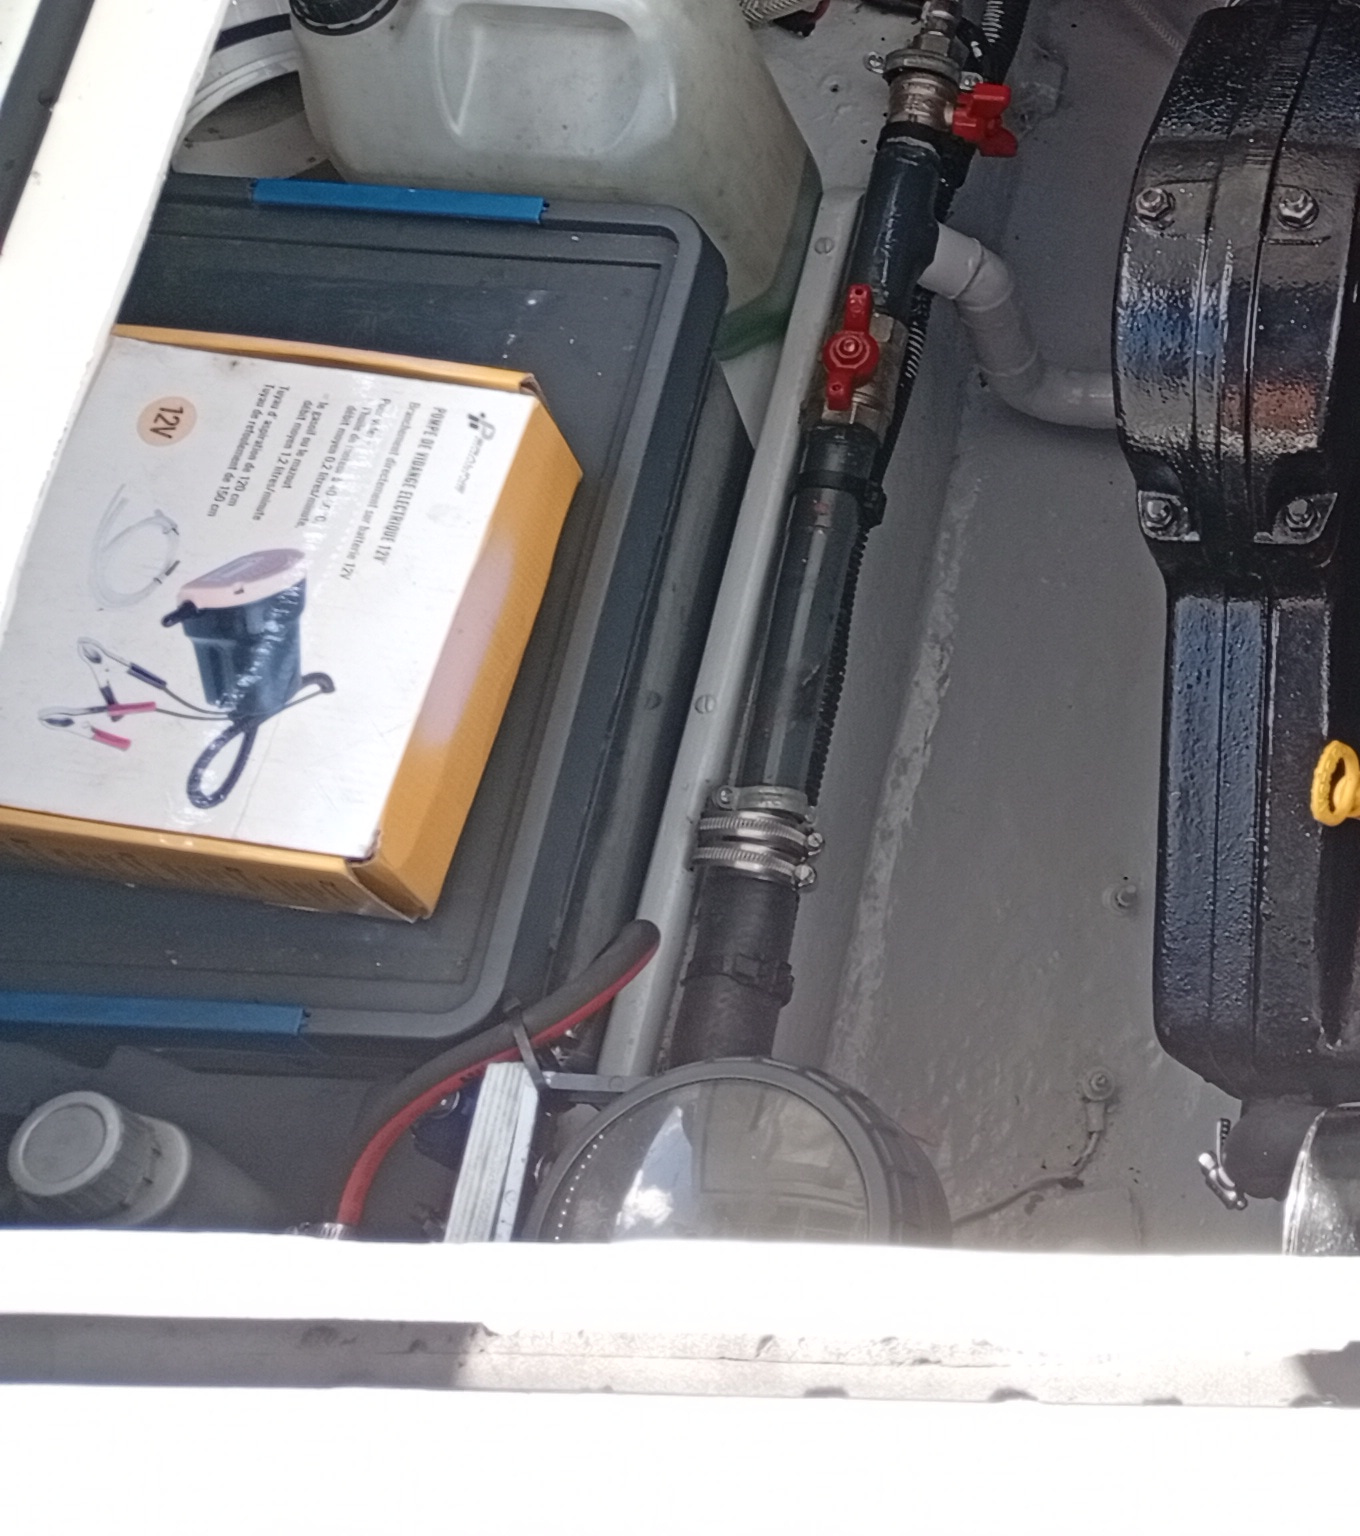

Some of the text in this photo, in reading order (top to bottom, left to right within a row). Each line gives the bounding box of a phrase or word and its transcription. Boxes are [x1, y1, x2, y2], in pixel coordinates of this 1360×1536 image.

[257, 385, 274, 407] Tuyau
[271, 387, 289, 409] Tuyau
[151, 408, 183, 438] 12V
[251, 410, 262, 419] de
[284, 423, 301, 448] moyen
[390, 402, 420, 455] Branchement
[248, 421, 272, 460] aspiration
[329, 428, 345, 454] moyen
[223, 473, 234, 482] de
[243, 463, 254, 472] de
[283, 459, 301, 488] mazout
[235, 477, 249, 491] 120
[368, 458, 396, 508] directement
[374, 408, 445, 561] POMPE DE VIDANGE ELECTRIQUE 12V
[208, 504, 219, 516] cm
[228, 494, 239, 506] cm
[363, 510, 373, 523] sur
[347, 526, 369, 559] batterie
[341, 564, 355, 579] 12V
